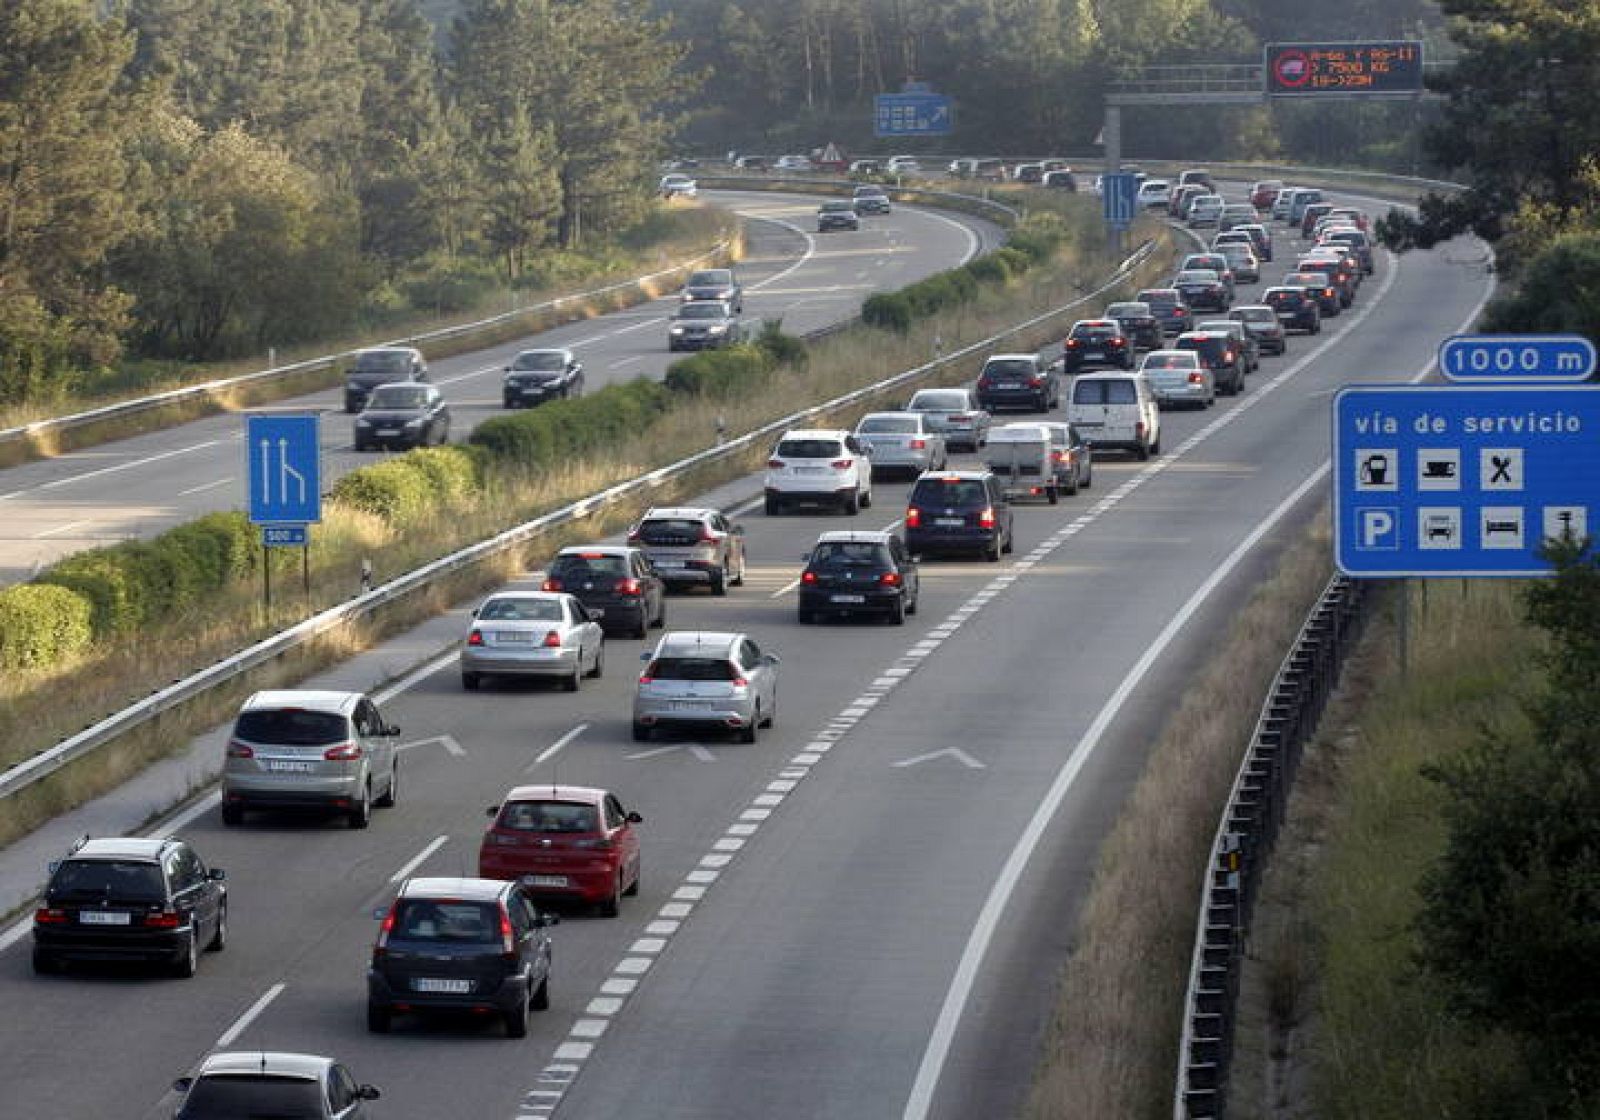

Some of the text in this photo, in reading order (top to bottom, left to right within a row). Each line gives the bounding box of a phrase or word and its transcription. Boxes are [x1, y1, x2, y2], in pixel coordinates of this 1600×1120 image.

[1455, 348, 1582, 371] 1000 m
[1355, 411, 1581, 435] vía de servicio
[1363, 511, 1392, 546] P
